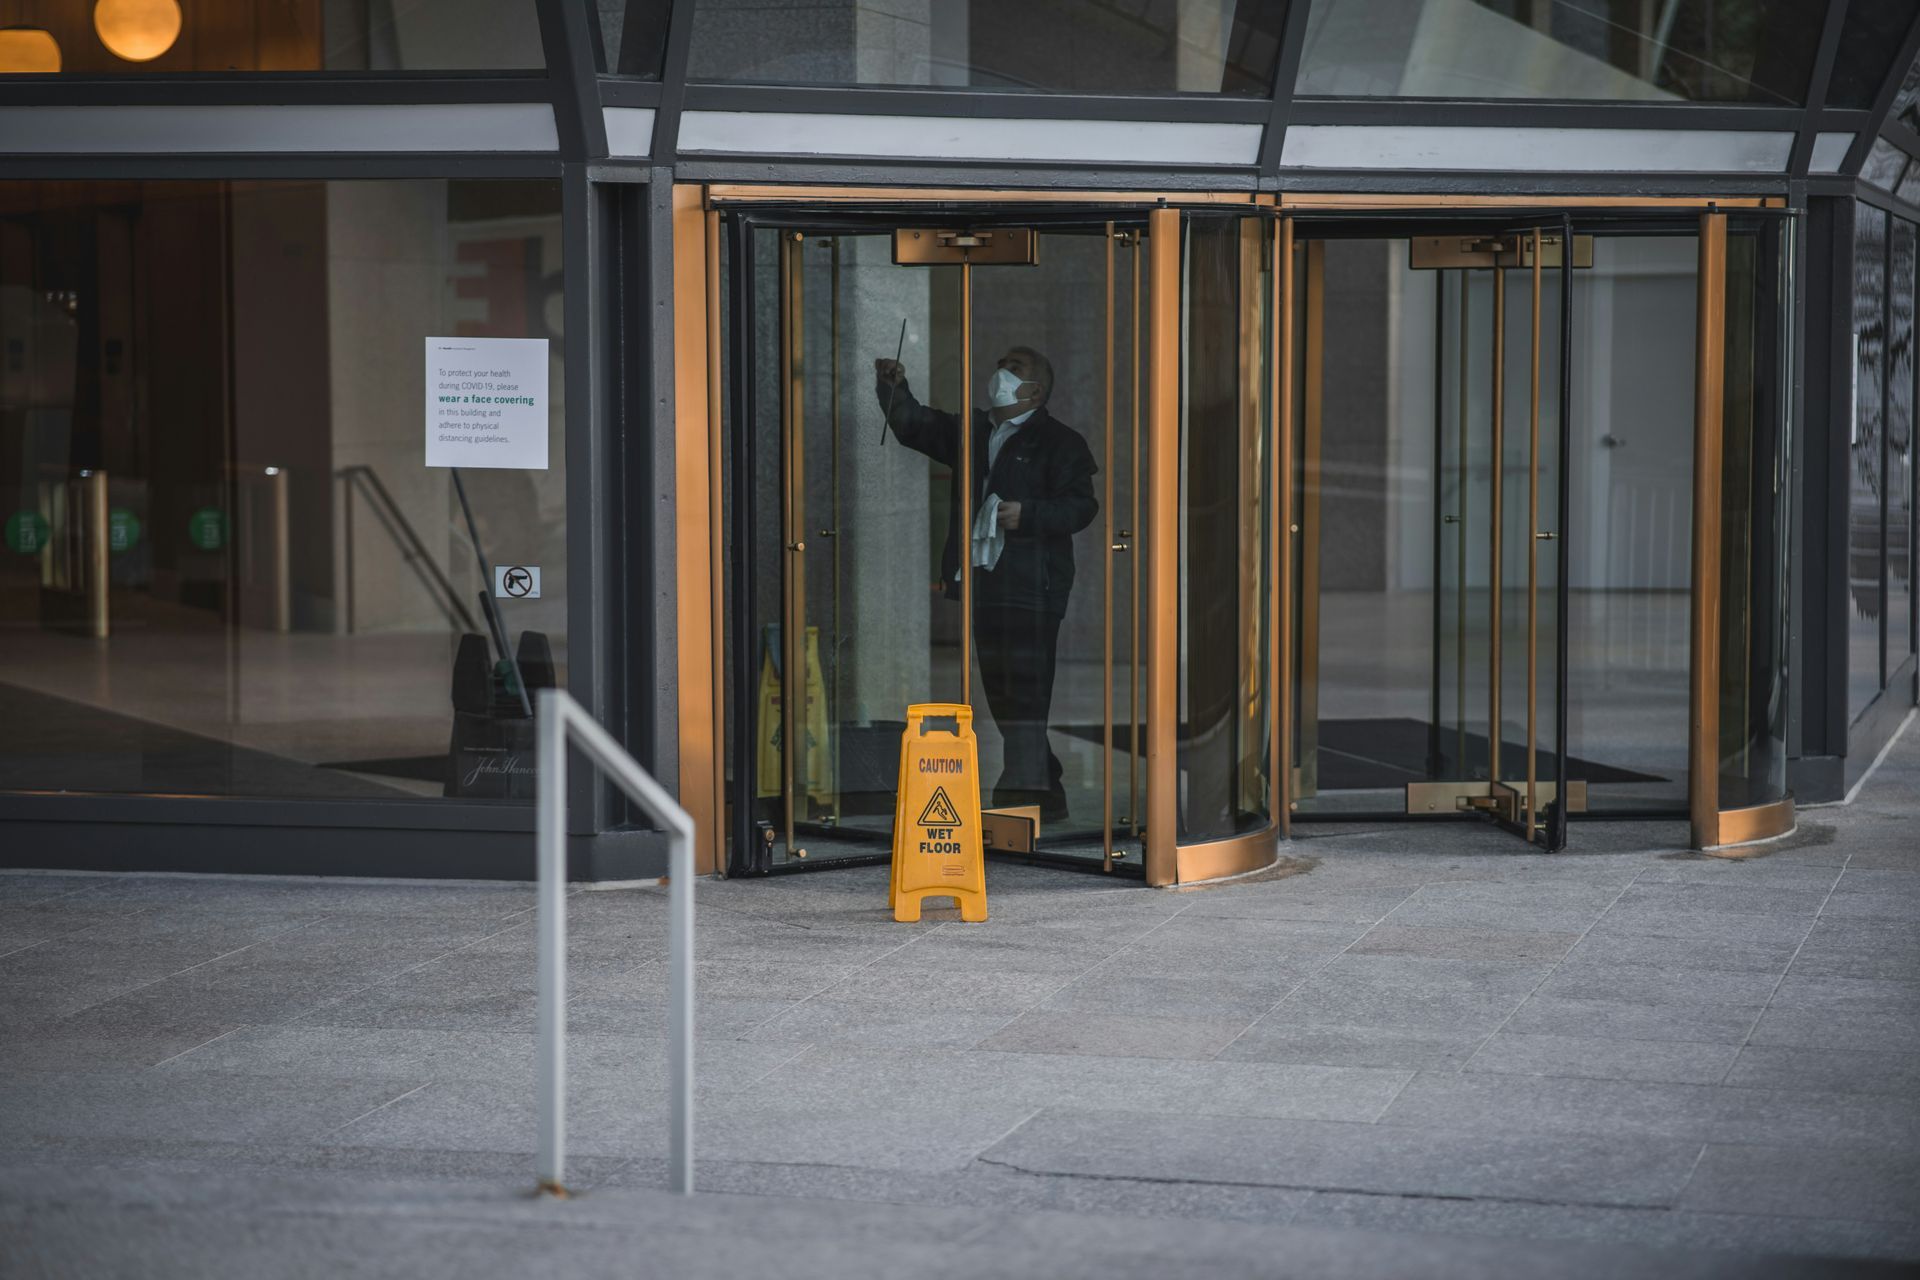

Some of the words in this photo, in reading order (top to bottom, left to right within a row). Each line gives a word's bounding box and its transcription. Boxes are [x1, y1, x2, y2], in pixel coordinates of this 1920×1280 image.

[439, 383, 460, 391] during
[439, 395, 460, 403] wear
[472, 395, 491, 403] face
[494, 396, 534, 406] covering
[461, 409, 486, 417] building
[439, 435, 472, 443] distancing
[919, 758, 962, 773] CAUTION
[927, 829, 953, 839] WET
[920, 842, 961, 854] FLOOR
